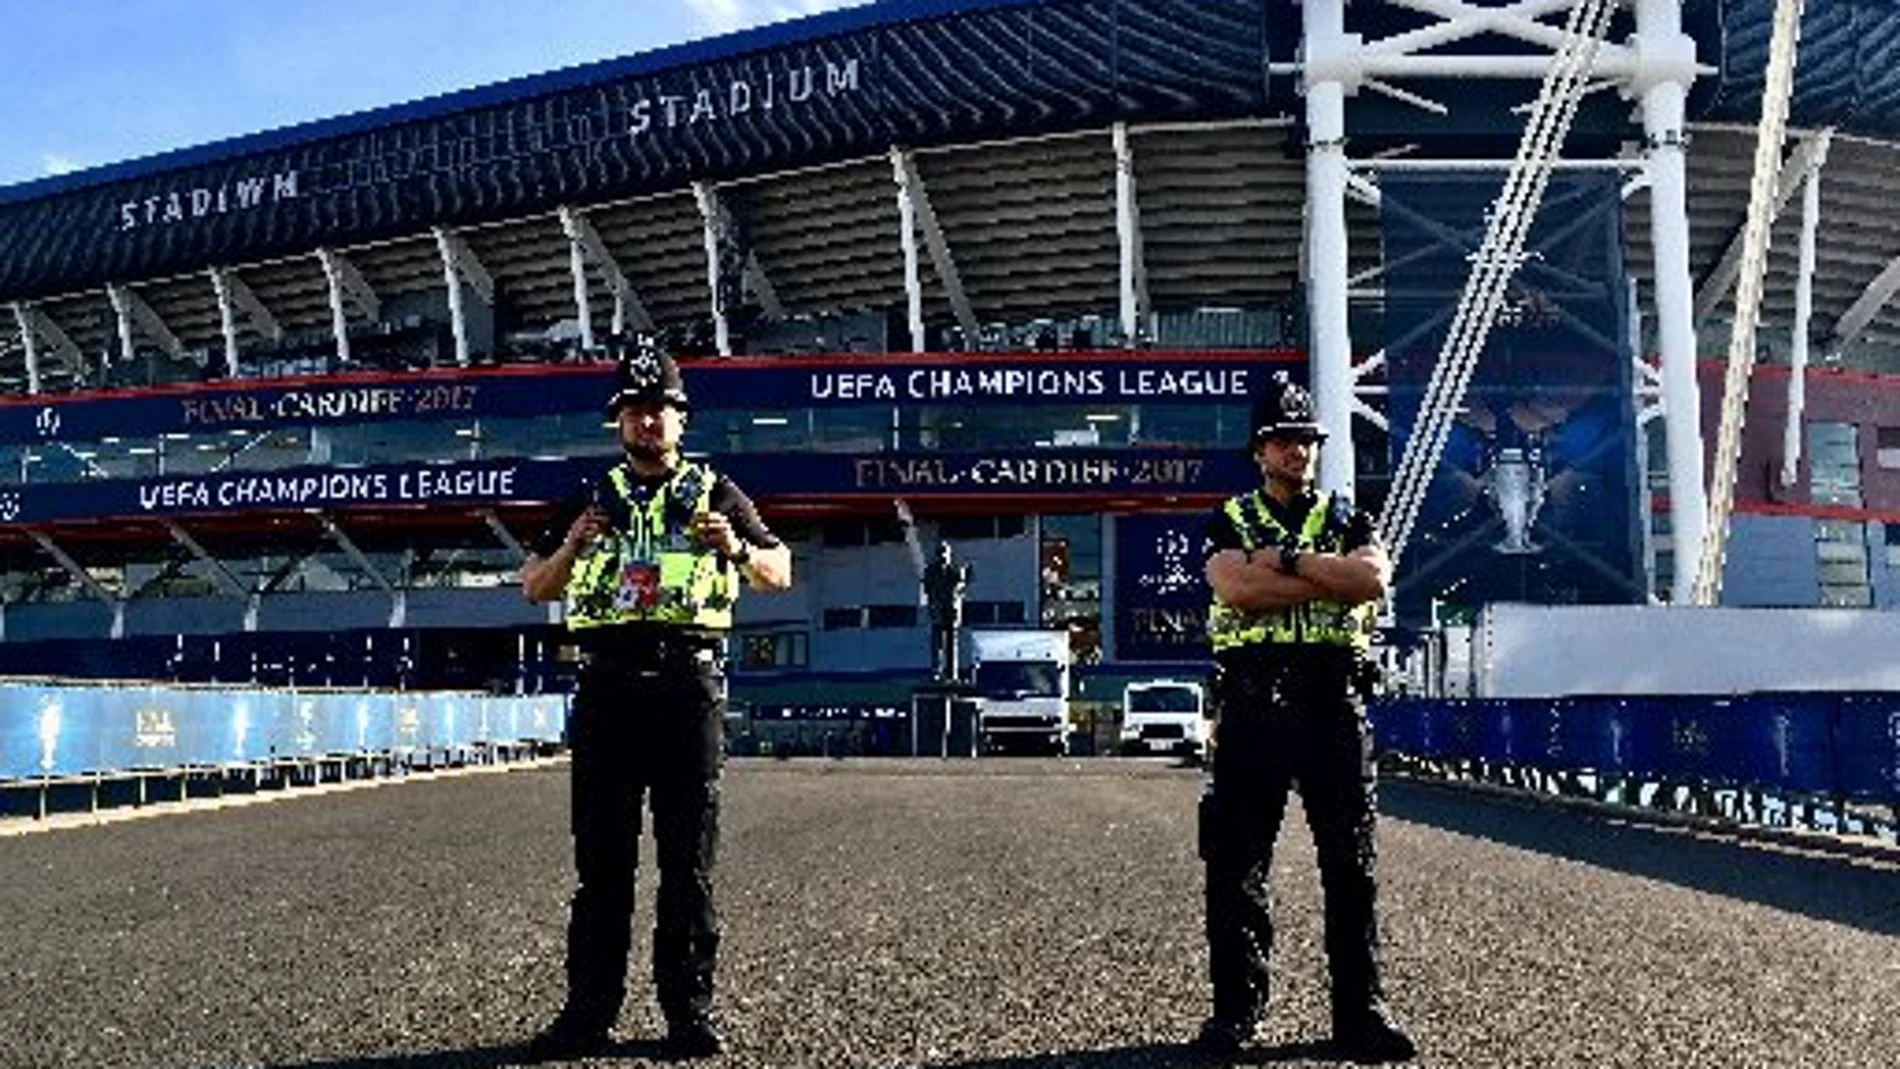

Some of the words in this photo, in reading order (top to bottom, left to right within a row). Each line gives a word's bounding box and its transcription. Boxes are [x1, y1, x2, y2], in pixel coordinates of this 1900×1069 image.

[630, 58, 861, 135] STADIUM
[120, 170, 299, 231] STADIWM
[811, 372, 897, 398] UEFA
[908, 370, 1104, 395] CHAMPIONS
[1118, 369, 1249, 394] LEAGUE
[140, 481, 209, 508] UEFA
[217, 473, 387, 505] CHAMPIONS
[399, 467, 516, 498] LEAGUE
